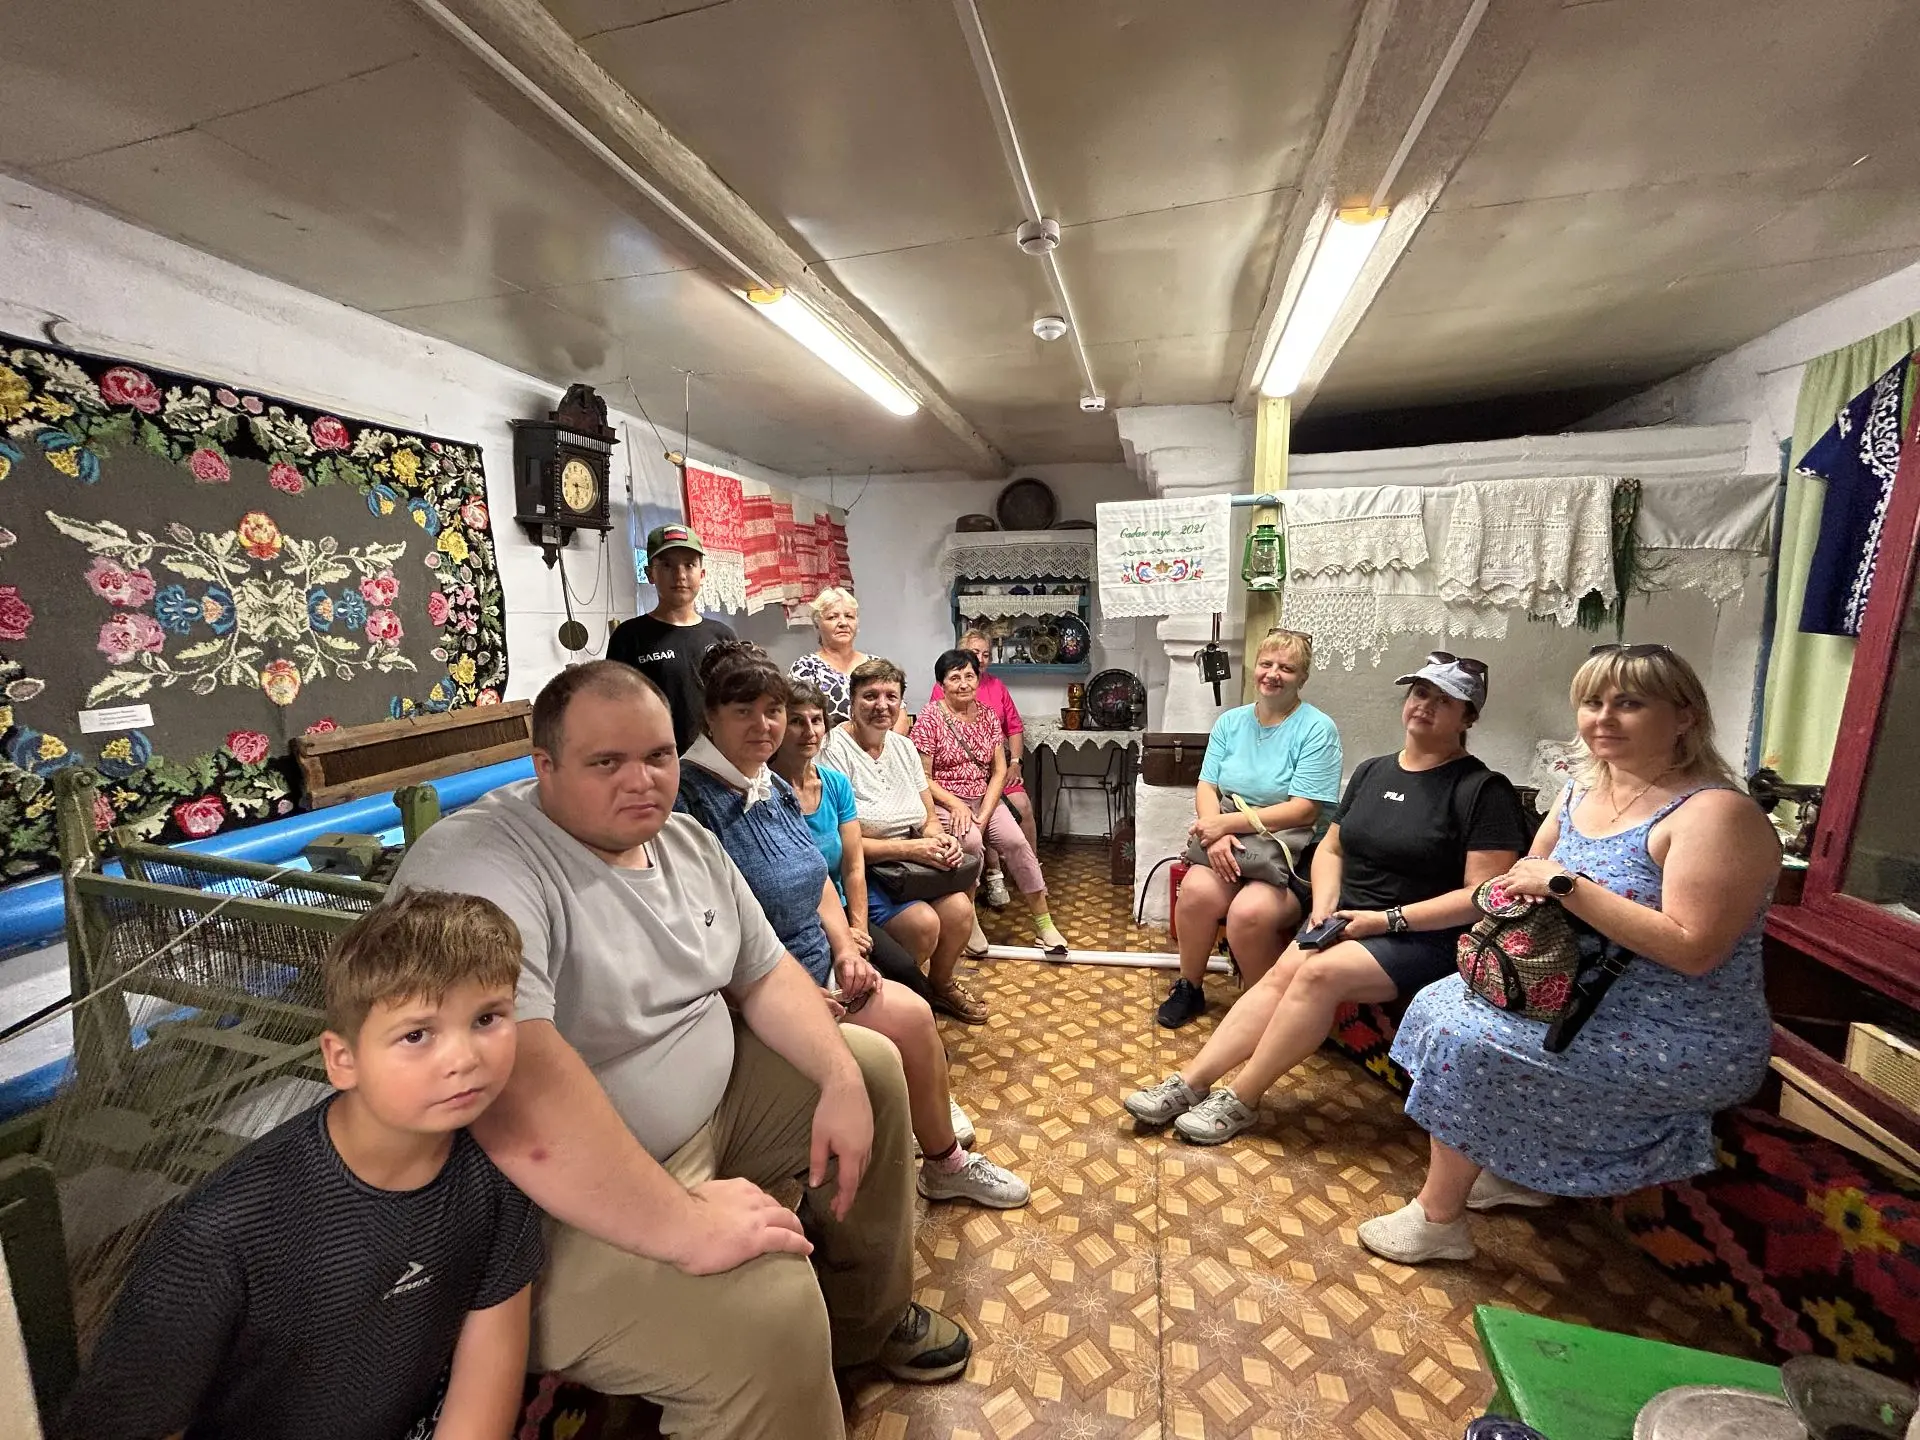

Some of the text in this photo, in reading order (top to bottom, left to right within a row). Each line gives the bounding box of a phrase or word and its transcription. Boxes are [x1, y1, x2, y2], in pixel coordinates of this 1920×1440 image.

[1180, 522, 1207, 535] 2021
[638, 650, 675, 663] БАБАЙ
[1384, 791, 1404, 801] FILA
